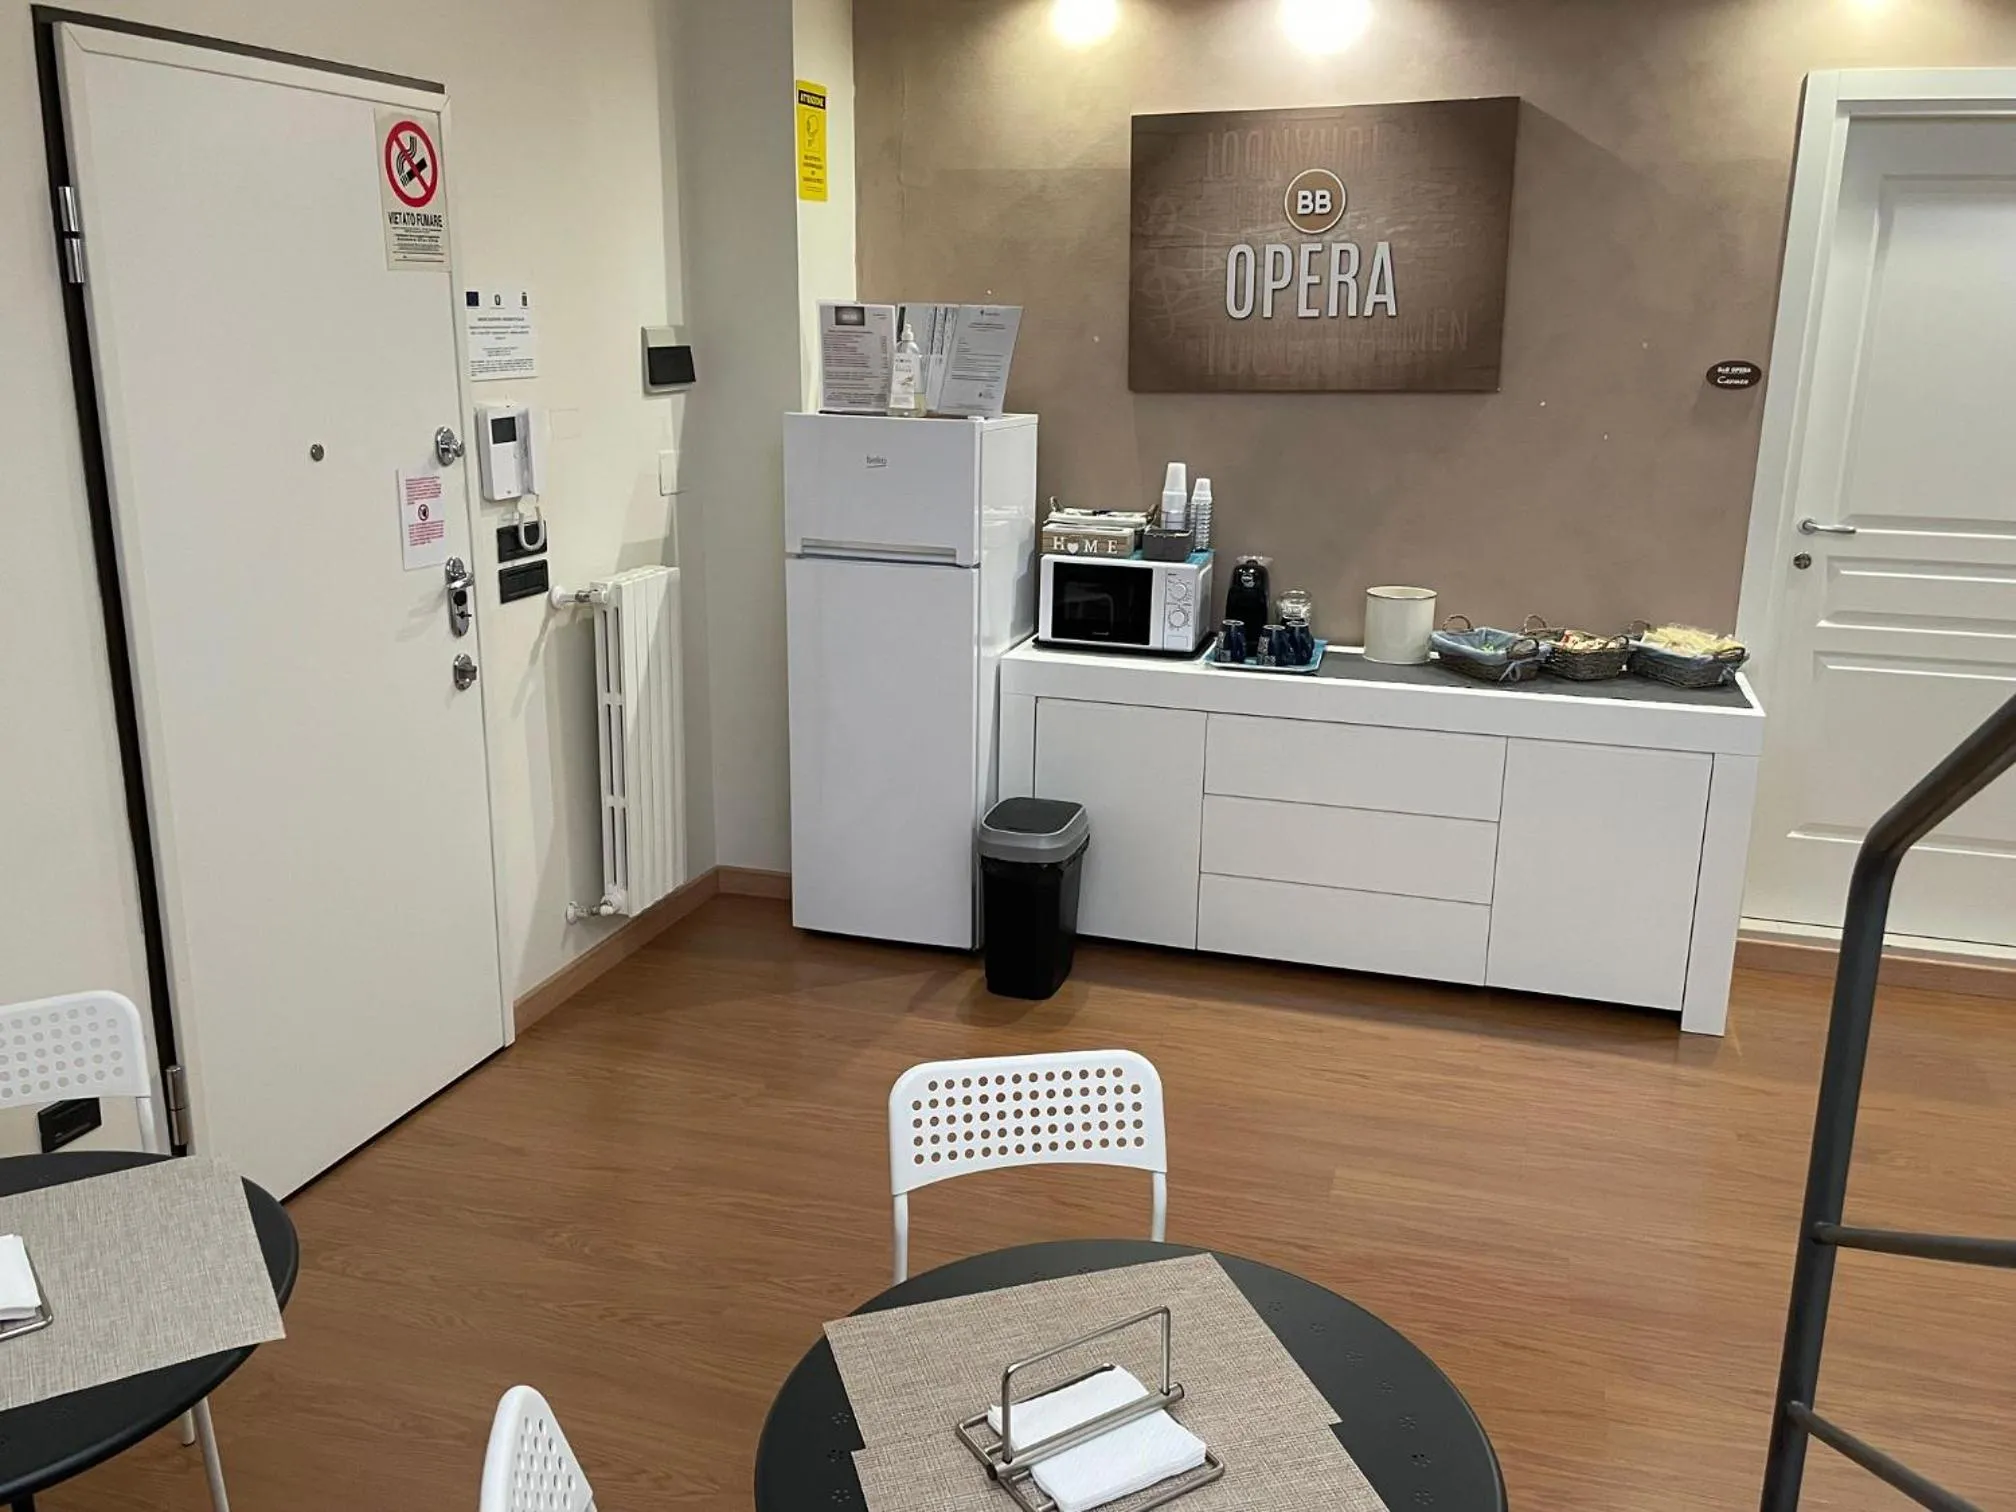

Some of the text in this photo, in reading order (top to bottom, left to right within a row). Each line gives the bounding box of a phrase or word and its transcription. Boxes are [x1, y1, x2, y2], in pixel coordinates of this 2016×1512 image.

[1296, 189, 1332, 215] BB
[388, 211, 443, 227] VIETATO FUMARE
[1225, 241, 1397, 320] OPERA
